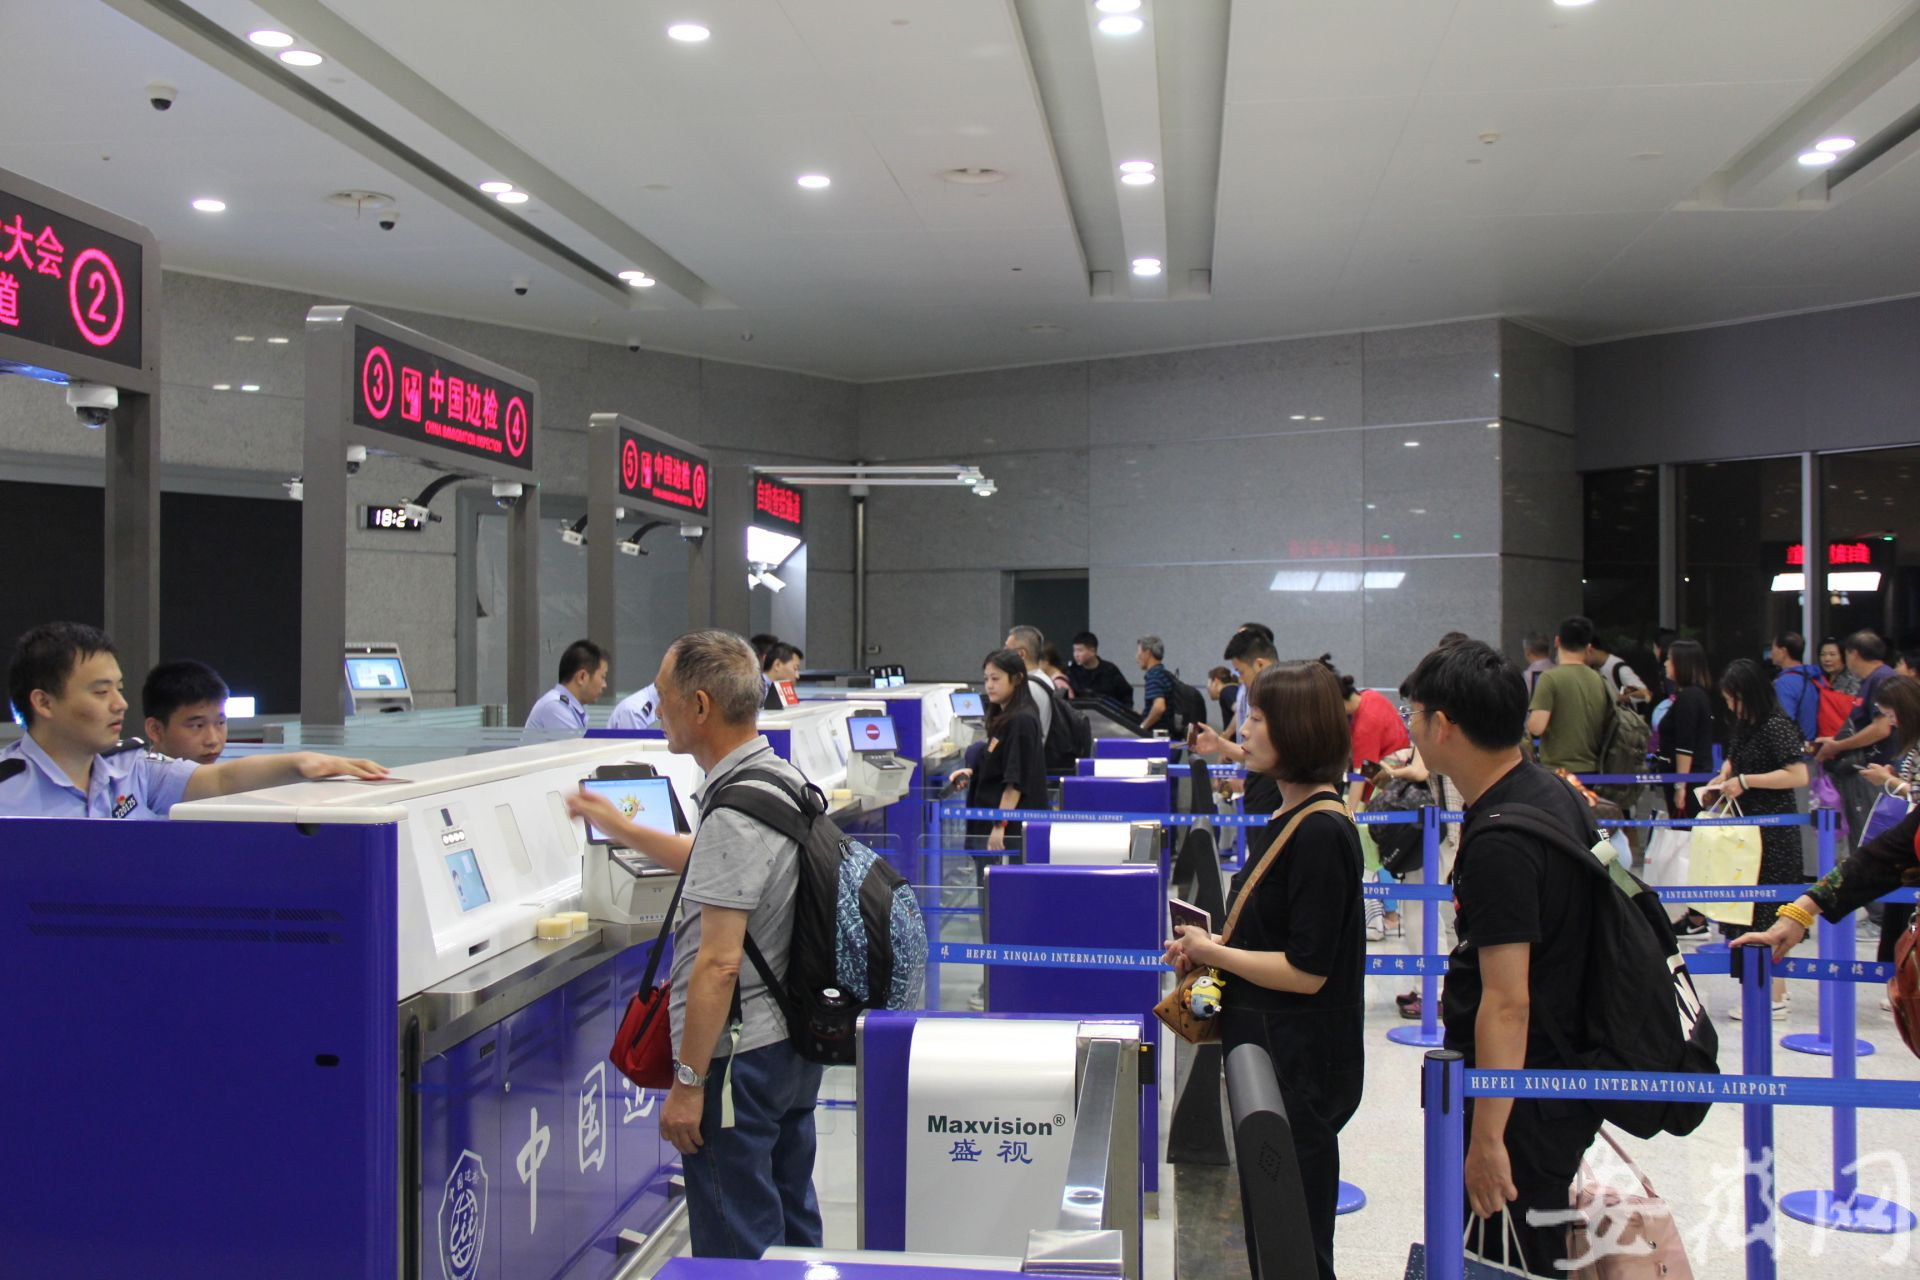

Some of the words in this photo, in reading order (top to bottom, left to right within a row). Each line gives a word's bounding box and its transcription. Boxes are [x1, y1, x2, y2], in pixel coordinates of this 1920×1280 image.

[0, 213, 65, 279] 大会
[429, 369, 499, 430] 中国边检
[1363, 887, 1390, 895] RPORT
[1666, 889, 1736, 899] INTERNATIONAL
[1740, 889, 1777, 898] AIRPORT
[966, 948, 998, 960] HEFEI
[1003, 950, 1047, 962] XINQIAO
[1051, 952, 1135, 965] INTERNATIONAL
[1471, 1076, 1515, 1090] HEFEI
[1524, 1076, 1588, 1092] XINQIAO
[1594, 1077, 1716, 1095] INTERNATIONAL
[1722, 1080, 1788, 1097] AIRPORT
[948, 1138, 1033, 1165] 盛视
